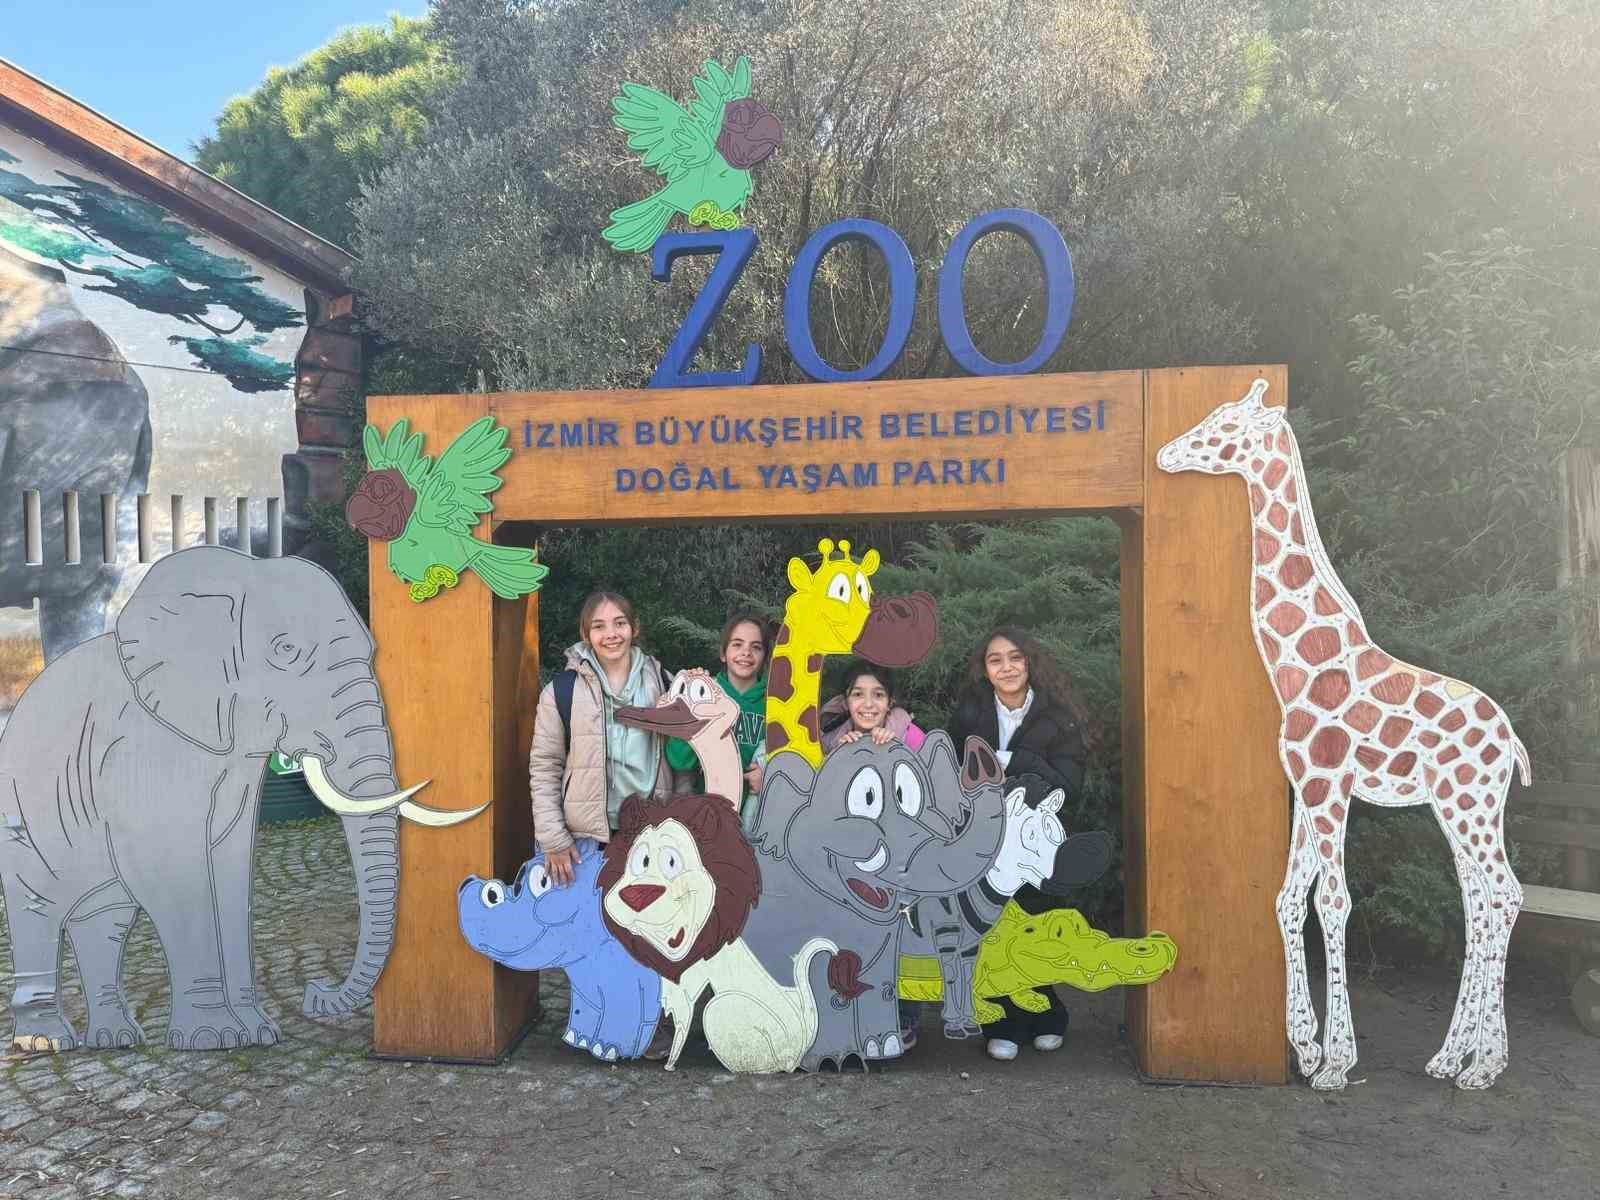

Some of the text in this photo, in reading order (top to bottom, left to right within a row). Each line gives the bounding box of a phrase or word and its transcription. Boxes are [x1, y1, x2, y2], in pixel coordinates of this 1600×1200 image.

[649, 207, 1075, 388] ZOO
[523, 400, 1106, 448] İZMİR BÜYÜKŞEHİR BELEDİYESİ
[616, 458, 1006, 494] DOĞAL YAŞAM PARKI
